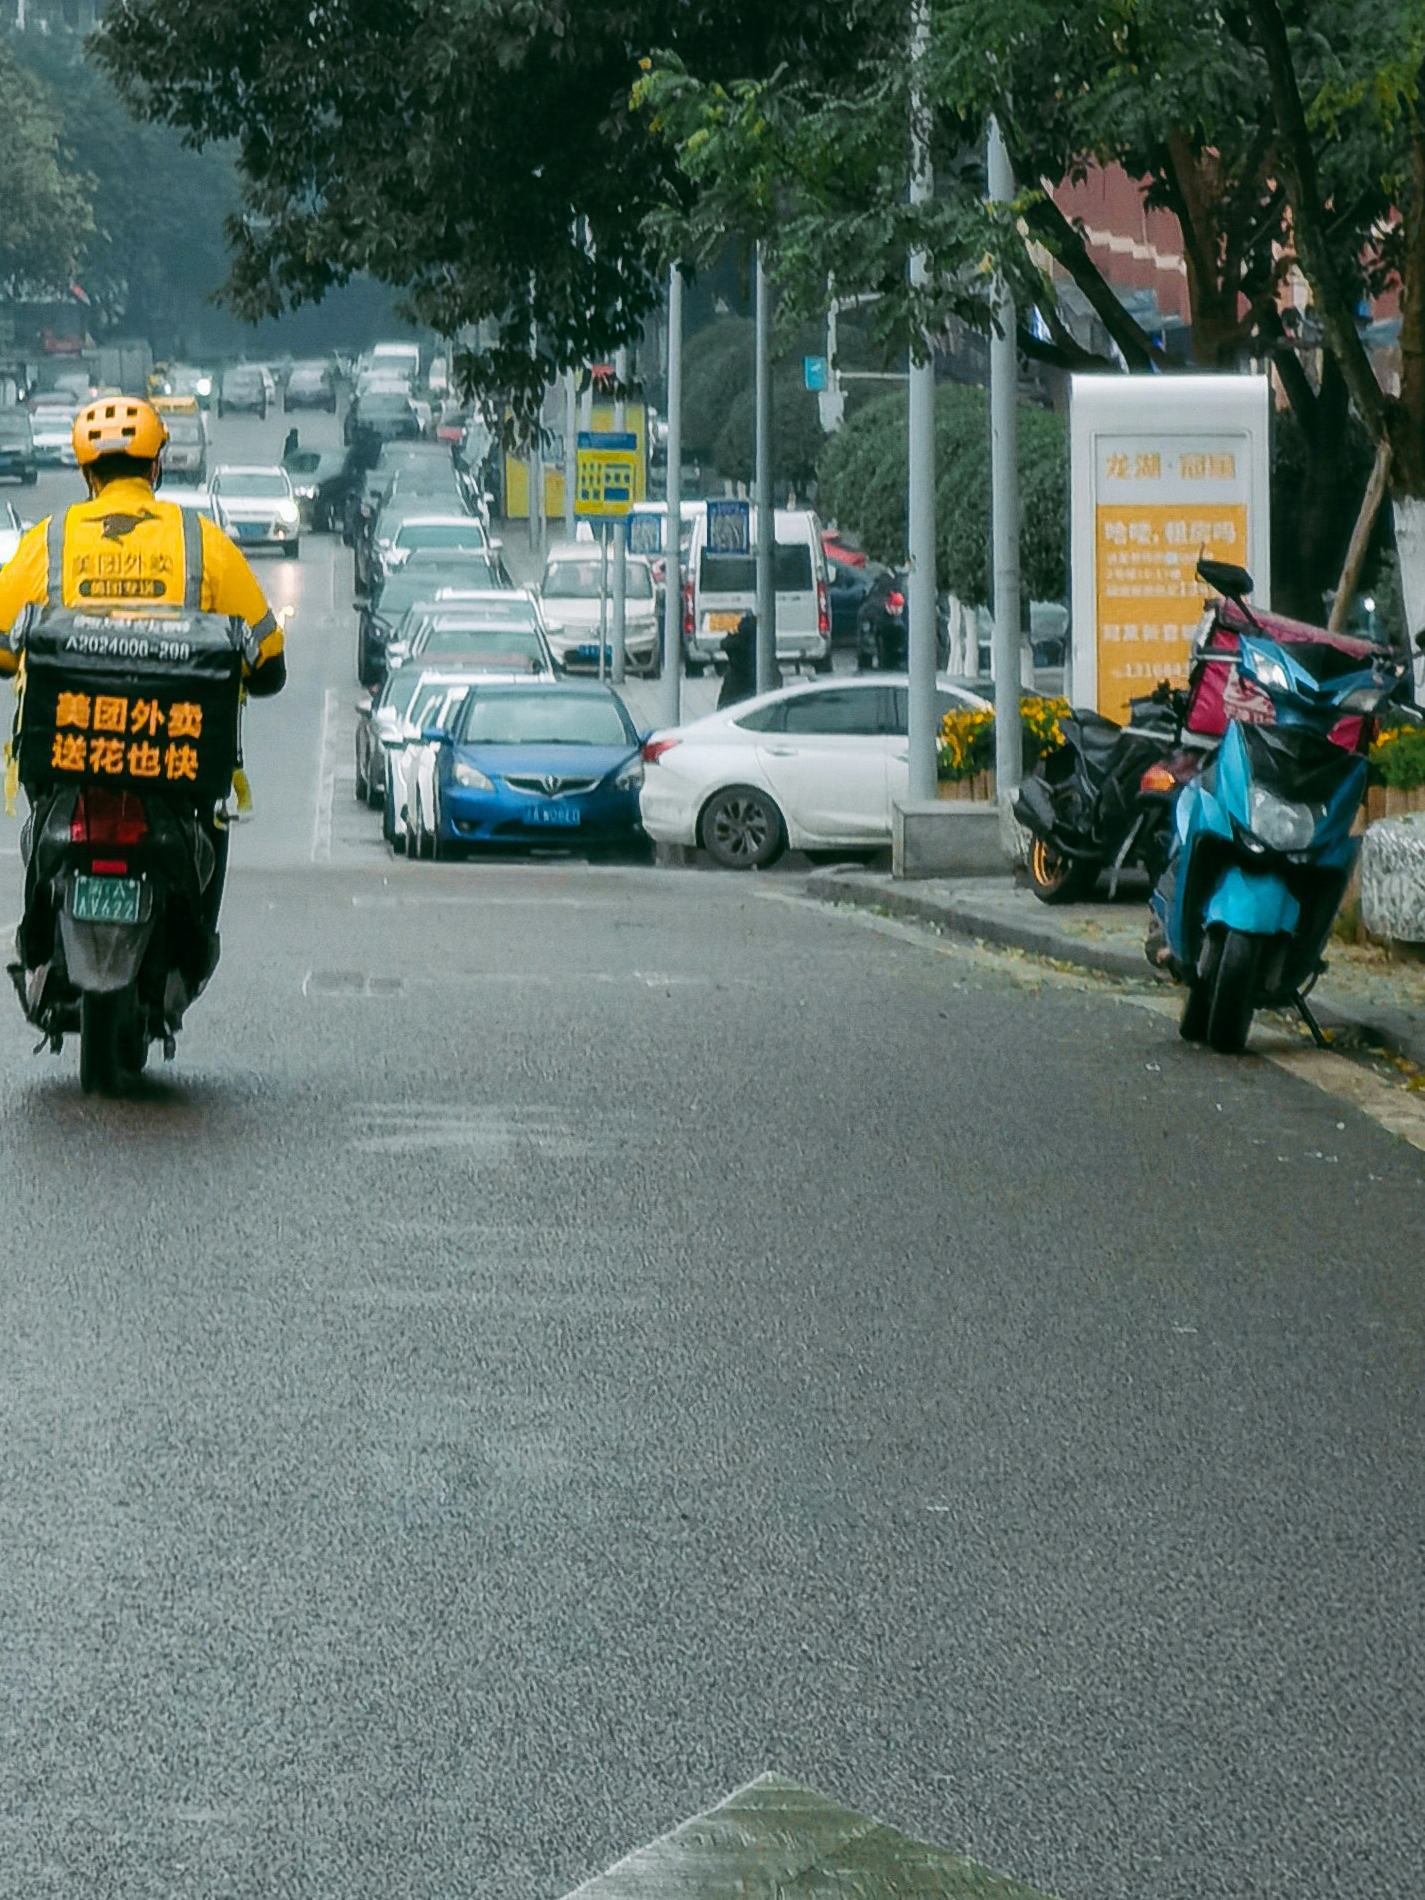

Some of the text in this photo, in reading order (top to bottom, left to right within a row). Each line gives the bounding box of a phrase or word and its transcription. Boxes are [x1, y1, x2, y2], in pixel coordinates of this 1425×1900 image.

[55, 690, 204, 739] 美团外卖
[50, 732, 199, 781] 送花也快
